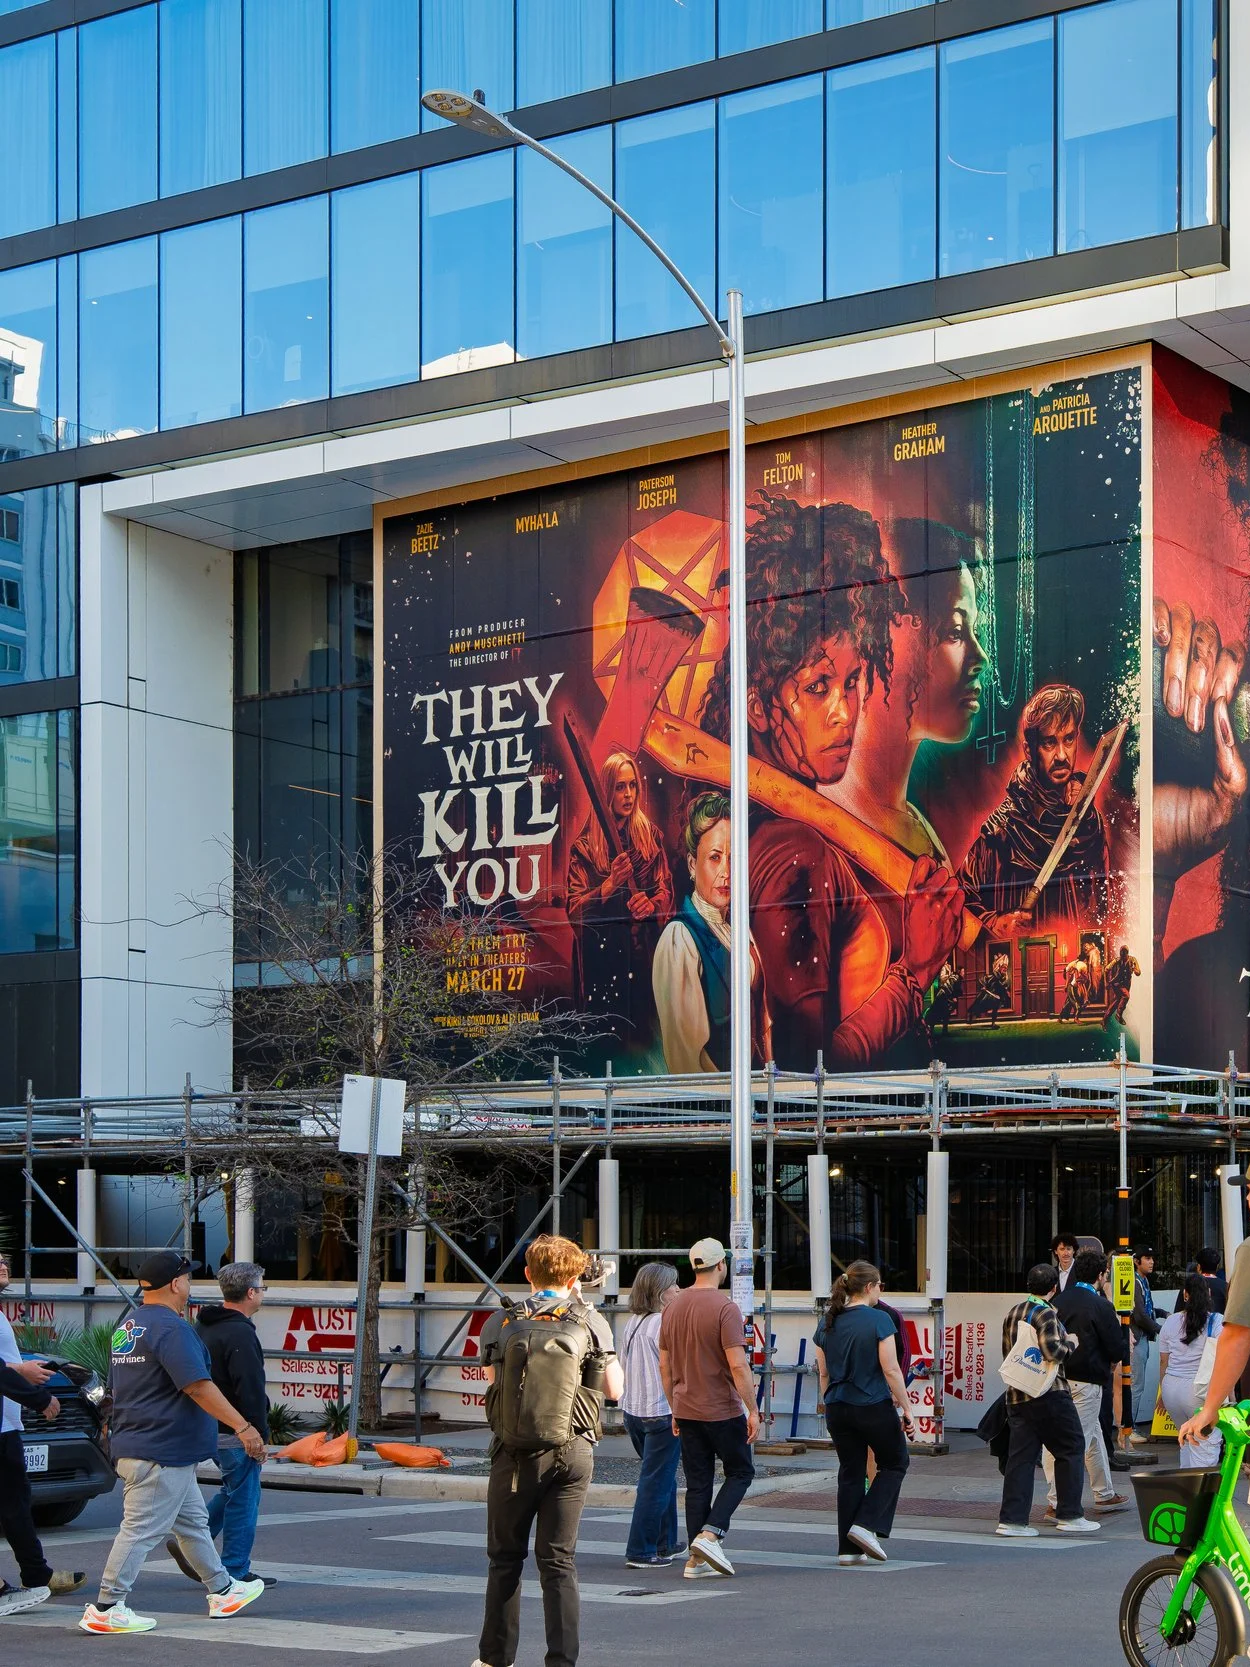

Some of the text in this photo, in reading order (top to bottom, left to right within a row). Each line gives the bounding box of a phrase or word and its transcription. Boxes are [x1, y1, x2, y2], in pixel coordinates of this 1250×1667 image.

[1039, 393, 1091, 414] AND PATRICIA
[902, 423, 937, 440] HEATHER
[1033, 406, 1098, 435] ARQUETTE
[775, 452, 791, 464] TOM
[893, 435, 945, 462] GRAHAM
[639, 474, 674, 491] PATERSON
[763, 463, 803, 486] FELTON
[636, 488, 677, 511] JOSEPH
[416, 522, 433, 535] ZAZIE
[515, 511, 559, 534] MYHA'LA
[411, 534, 439, 554] BEETZ
[449, 618, 525, 639] FROM PRODUCER
[449, 632, 525, 655] ANDY MUSCHIETTI
[449, 658, 462, 668] THE
[464, 652, 498, 666] DIRECTOR
[500, 650, 509, 660] OF
[410, 672, 565, 745] THEY
[442, 733, 532, 784] WILL
[417, 774, 559, 858] KILL
[436, 855, 541, 908] YOU
[506, 933, 526, 948] TRY
[470, 954, 479, 966] IN
[483, 952, 525, 966] THEATERS
[446, 967, 526, 993] MARCH 27
[0, 1302, 54, 1322] USTIN
[126, 1355, 146, 1363] vines
[282, 1359, 314, 1373] Sales
[317, 1360, 327, 1374] &
[945, 1326, 963, 1400] AUSTIN
[976, 1322, 985, 1401] 512-928-1136
[461, 1366, 488, 1381] Sale
[965, 1374, 973, 1401] Sales
